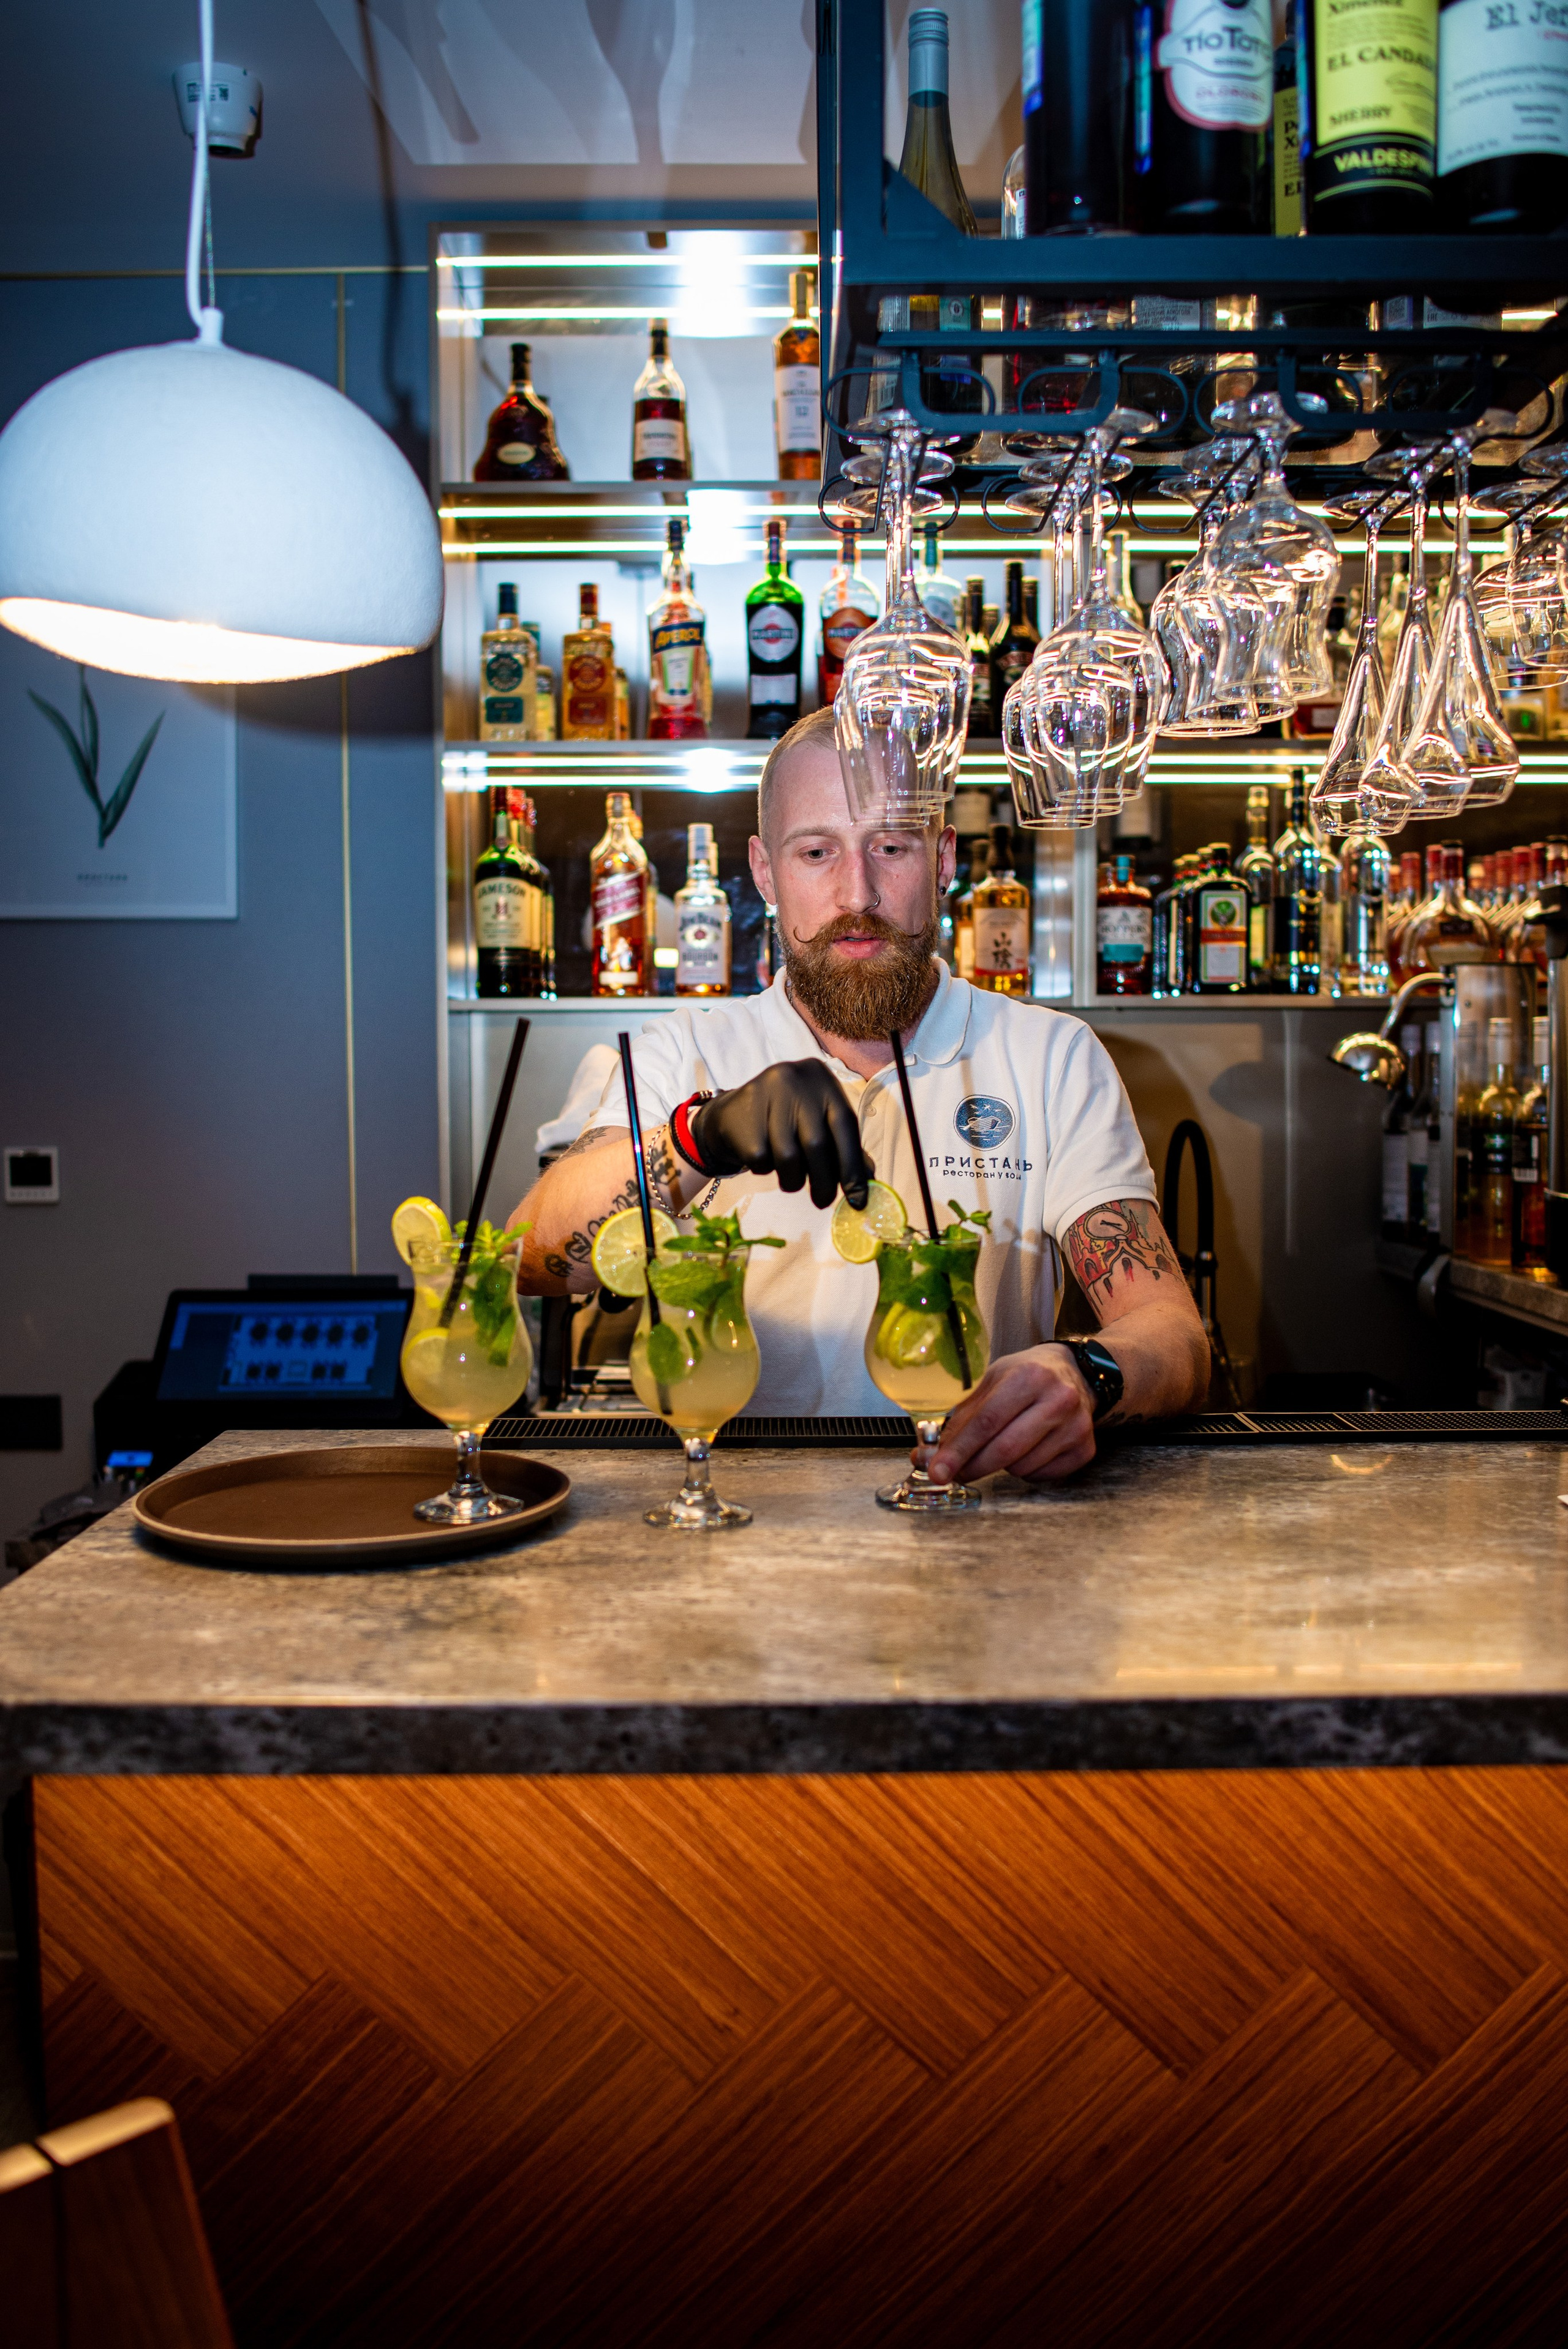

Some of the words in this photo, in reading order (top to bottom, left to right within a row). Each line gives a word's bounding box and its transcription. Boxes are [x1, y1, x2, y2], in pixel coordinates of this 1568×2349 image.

[655, 627, 701, 649] APEROL
[929, 1156, 1033, 1172] ПРИСТАНЬ
[943, 1169, 995, 1179] ресторан
